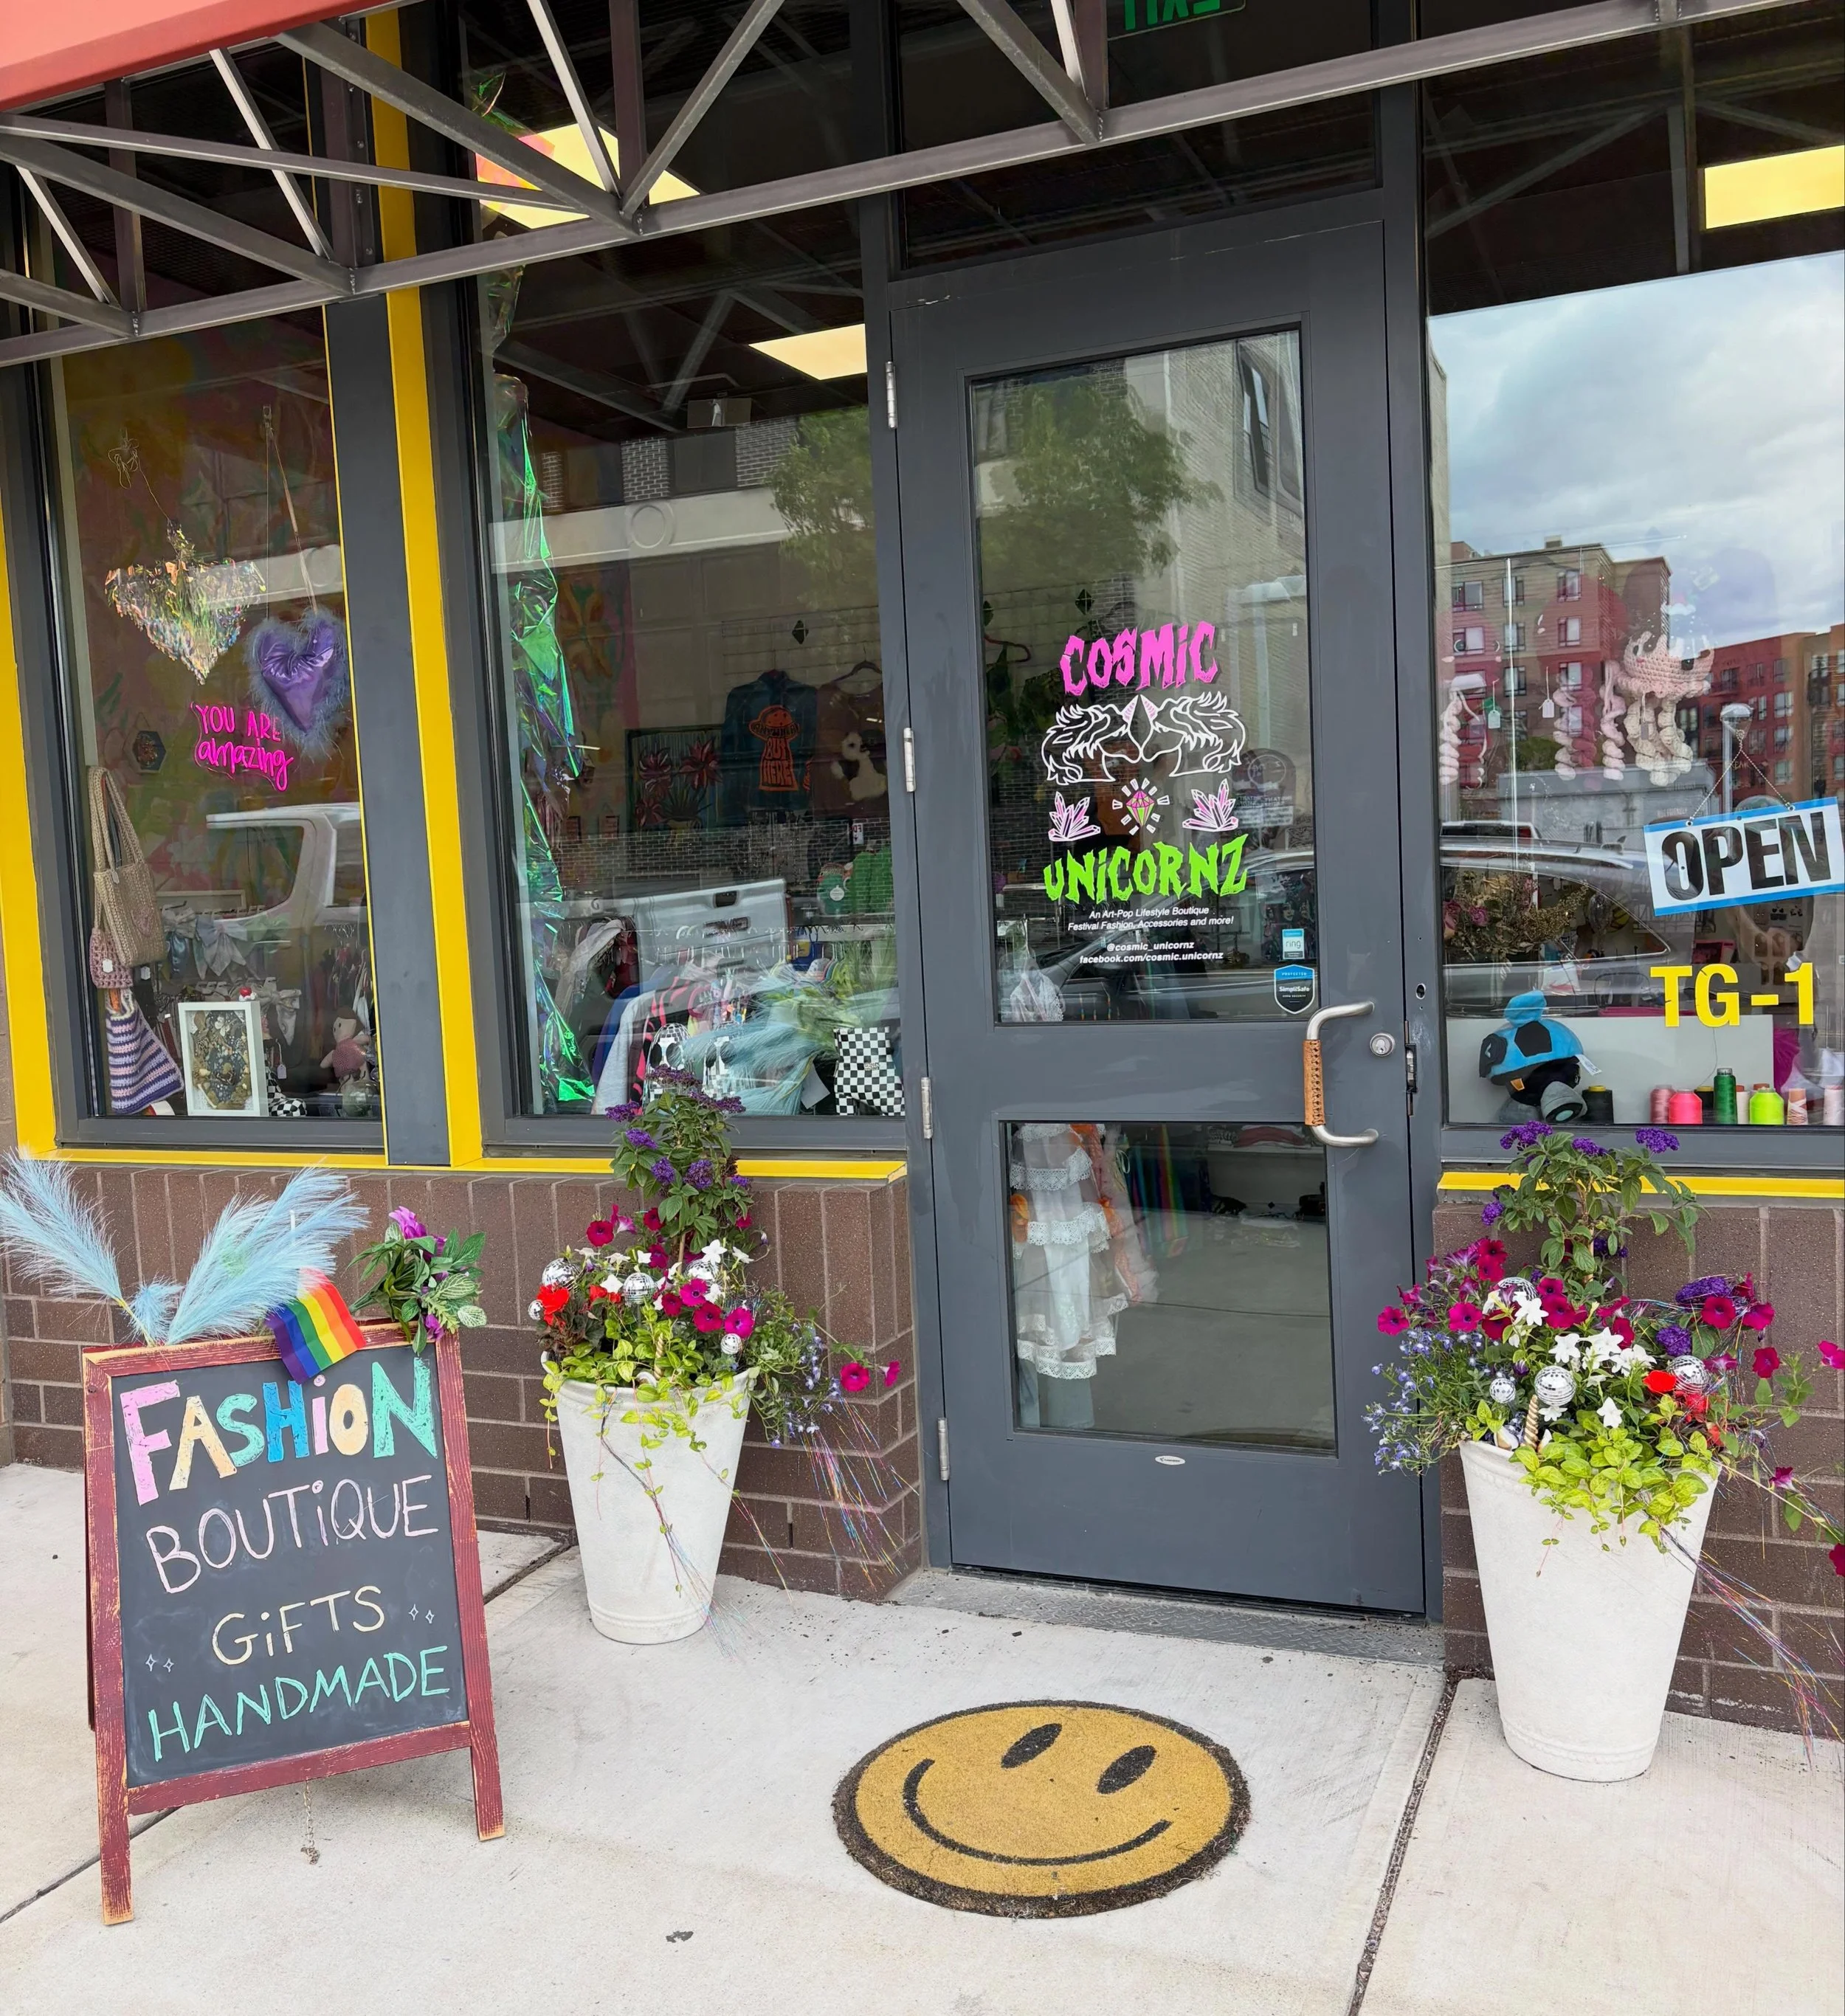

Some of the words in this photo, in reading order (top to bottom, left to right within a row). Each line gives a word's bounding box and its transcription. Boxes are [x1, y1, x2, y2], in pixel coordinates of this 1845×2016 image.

[195, 705, 235, 734] YOU
[247, 711, 282, 742] ARE
[197, 738, 294, 792] amazing
[1661, 811, 1832, 901] OPEN
[1089, 911, 1100, 919] An
[1102, 908, 1134, 920] Art-Pop
[1136, 907, 1170, 919] Lifestyle
[1172, 906, 1210, 916] Boutique
[1068, 920, 1099, 931] Festival
[1100, 919, 1134, 930] Fashion,
[1134, 917, 1187, 928] Accessories
[1190, 916, 1207, 926] and
[1209, 915, 1234, 925] more!
[1107, 941, 1195, 952] @cosmic_unicornz
[1286, 939, 1301, 949] ring
[1080, 951, 1224, 964] facebook.com/cosmic.unicornz
[1279, 985, 1310, 993] SimpliSafe
[1649, 962, 1814, 1027] TG-1
[148, 1645, 450, 1762] HANDMADE
